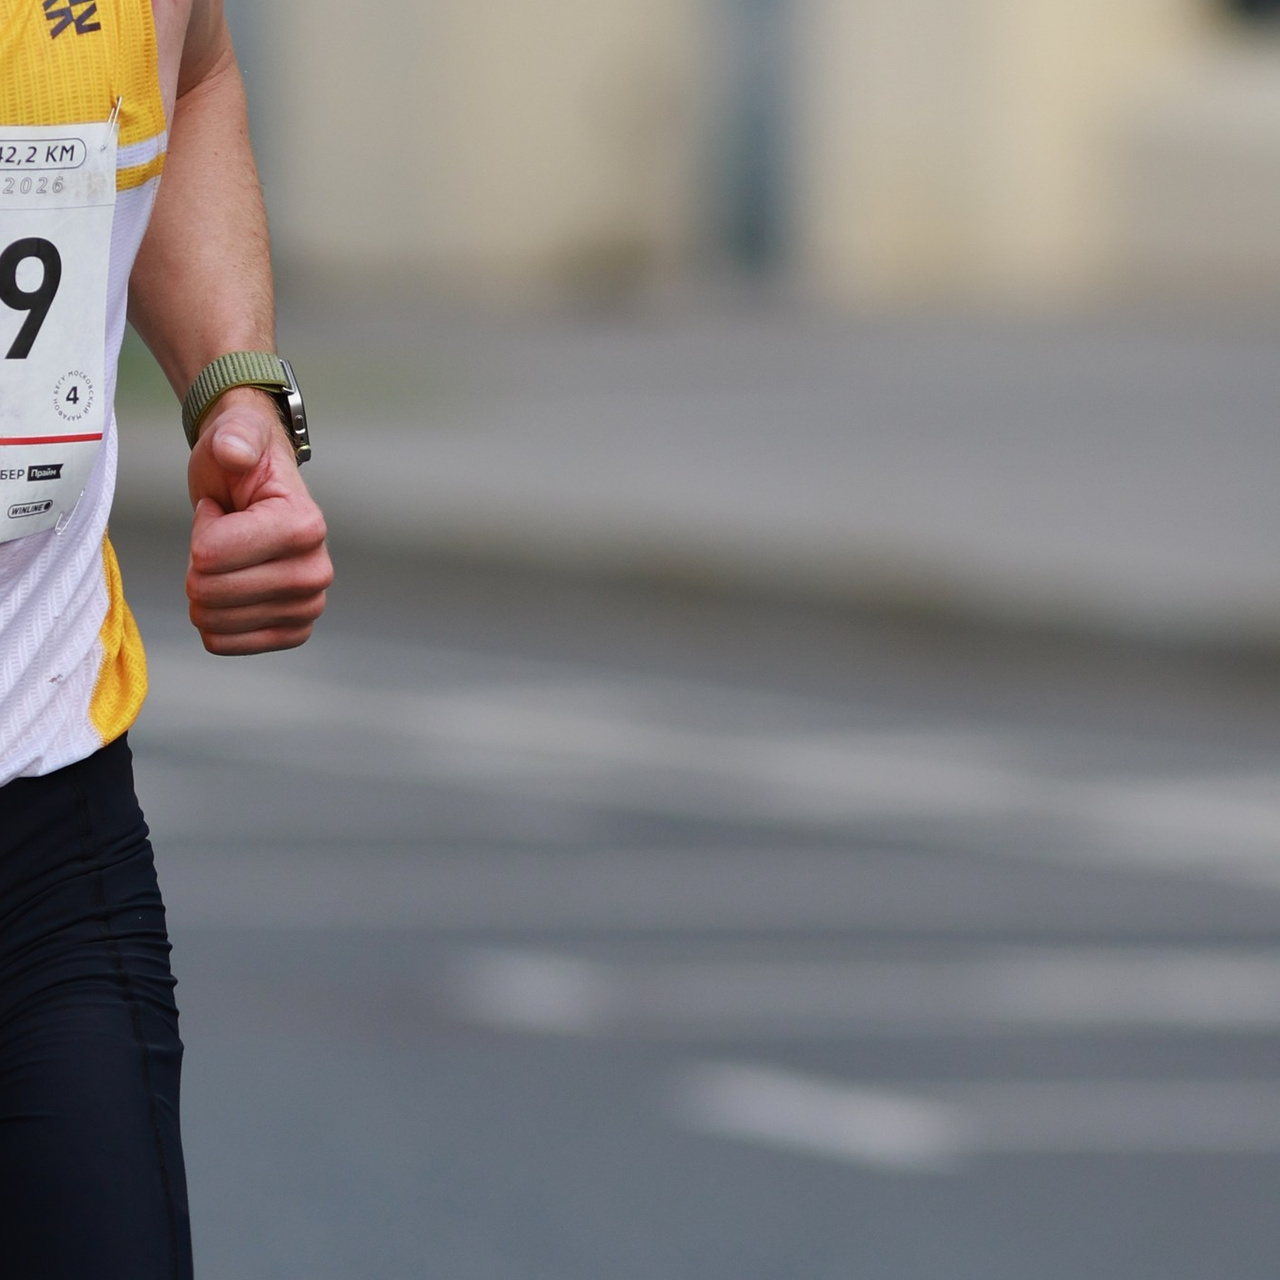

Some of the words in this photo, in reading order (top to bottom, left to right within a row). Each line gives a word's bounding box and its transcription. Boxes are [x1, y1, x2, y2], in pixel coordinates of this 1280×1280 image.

[45, 145, 75, 163] КМ
[2, 176, 64, 194] 2026
[65, 386, 80, 404] 4
[30, 467, 57, 478] Прайм
[10, 503, 43, 516] WINLINE
